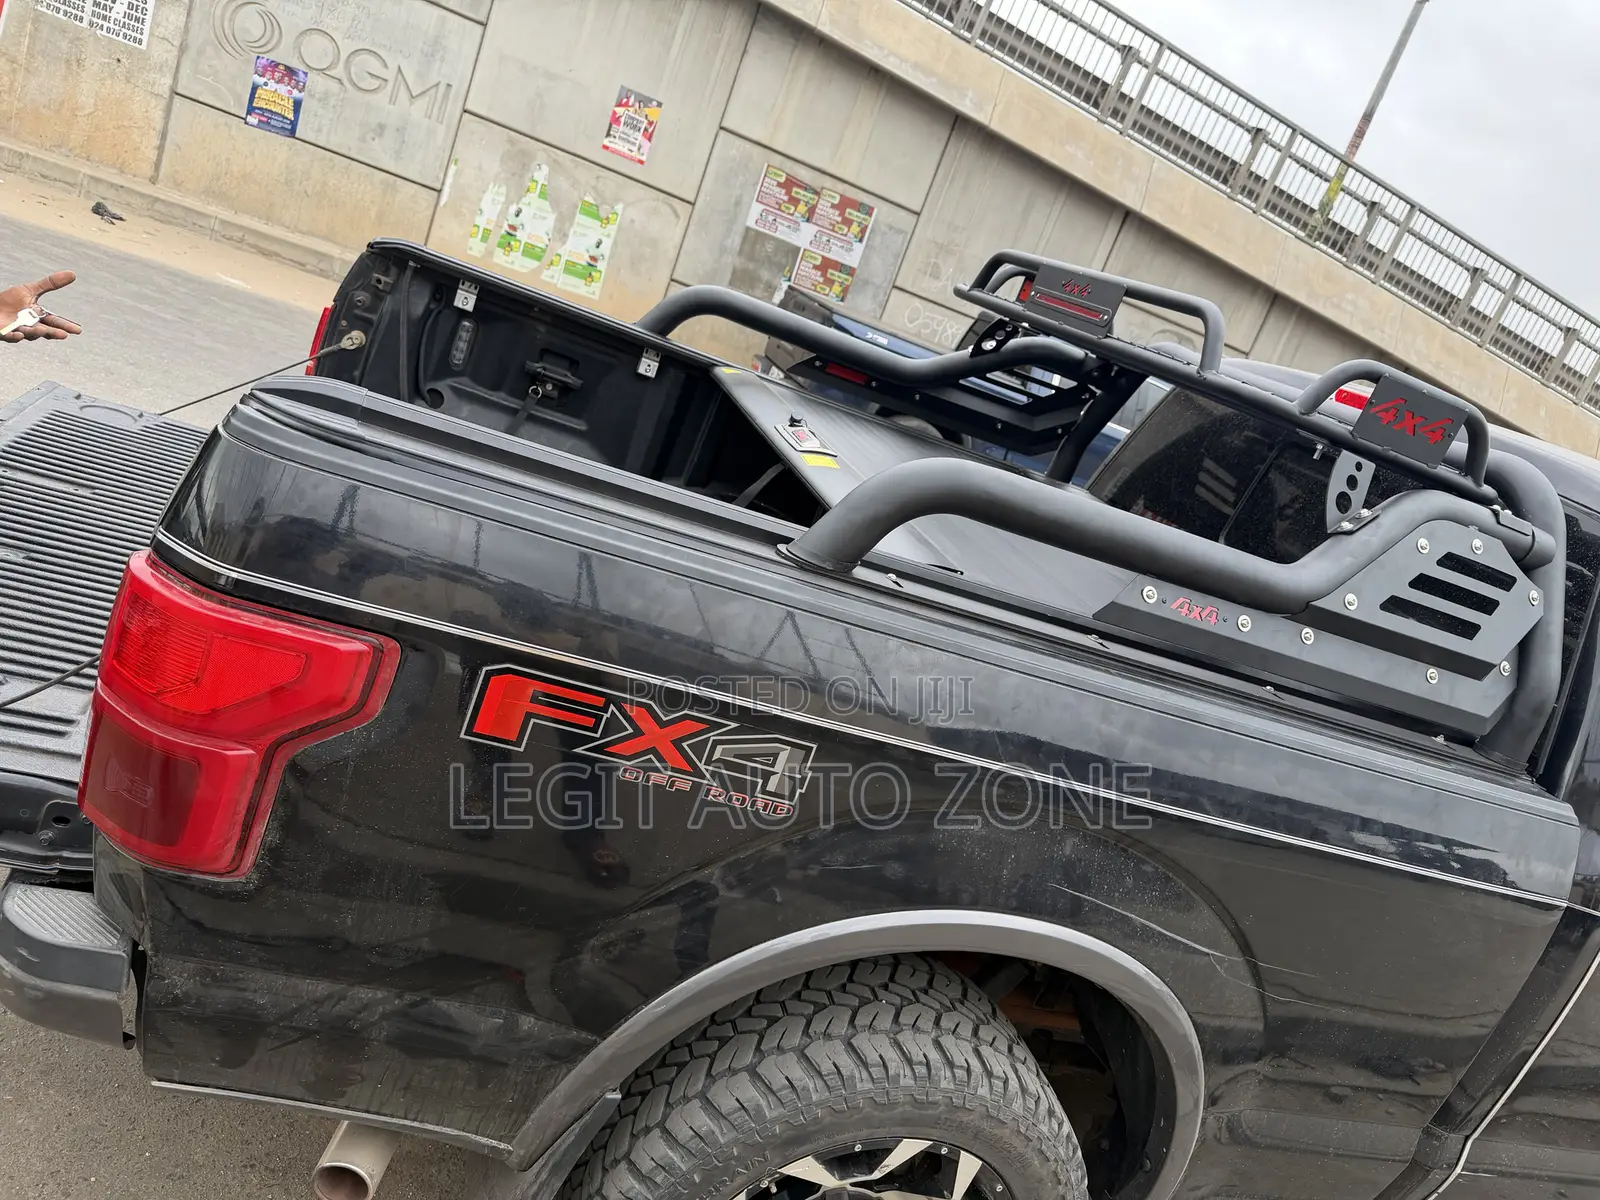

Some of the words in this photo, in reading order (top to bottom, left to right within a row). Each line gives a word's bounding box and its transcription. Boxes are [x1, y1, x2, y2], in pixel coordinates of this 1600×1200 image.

[62, 9, 84, 24] 9288
[92, 0, 114, 14] MAY
[122, 11, 147, 27] JUNE
[127, 1, 148, 17] DEC
[90, 9, 112, 25] HOME
[113, 17, 145, 37] CLASSES
[122, 32, 144, 46] 9288
[293, 27, 453, 125] QGMI
[460, 664, 818, 805] FX4
[618, 765, 694, 793] OFF
[702, 785, 794, 817] ROAD
